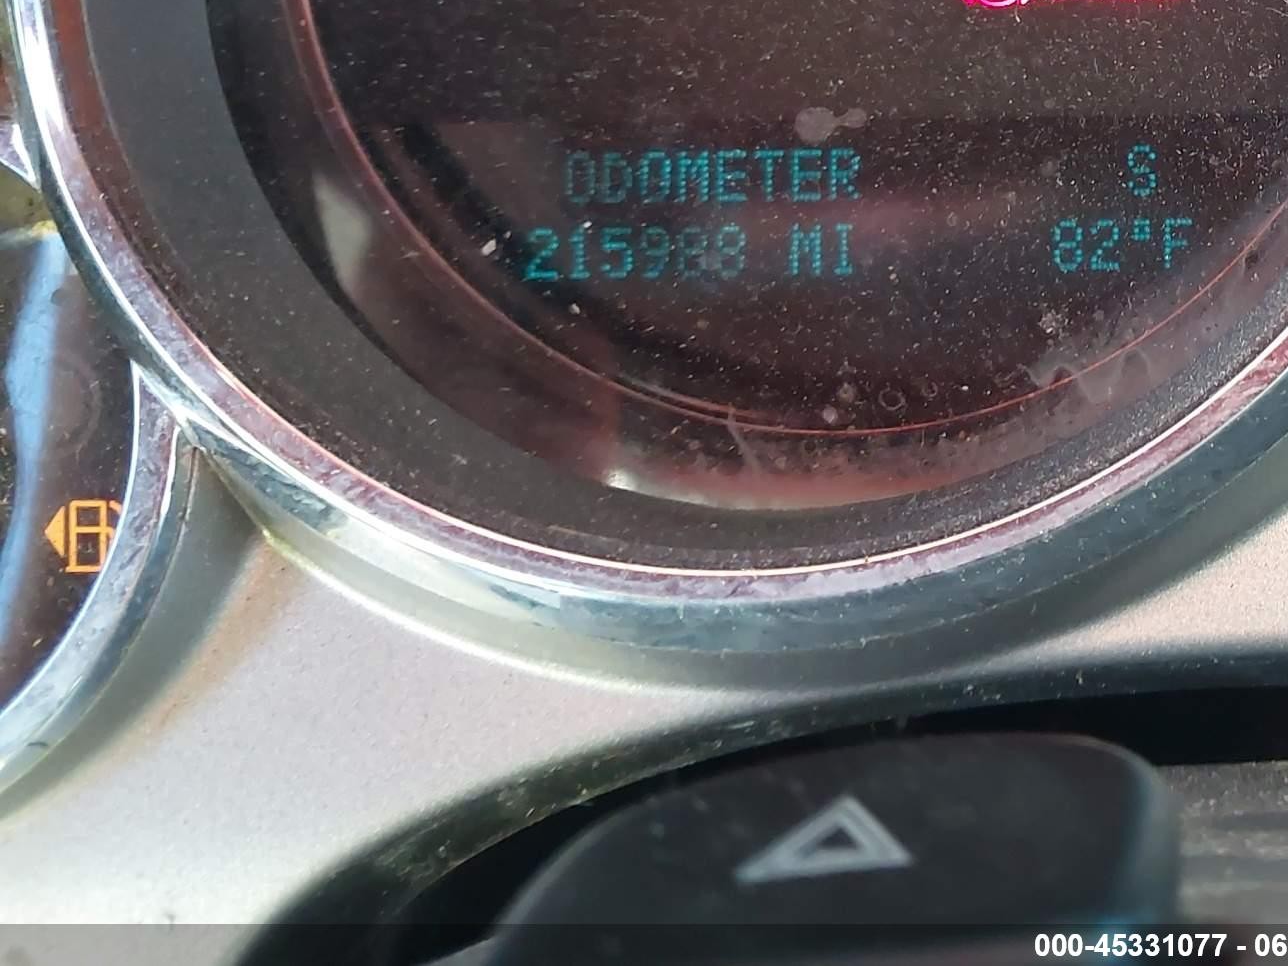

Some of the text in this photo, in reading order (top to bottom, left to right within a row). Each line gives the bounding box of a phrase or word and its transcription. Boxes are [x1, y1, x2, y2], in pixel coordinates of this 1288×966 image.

[565, 147, 861, 205] ODOMETER
[1126, 144, 1157, 198] S
[788, 221, 856, 277] MI
